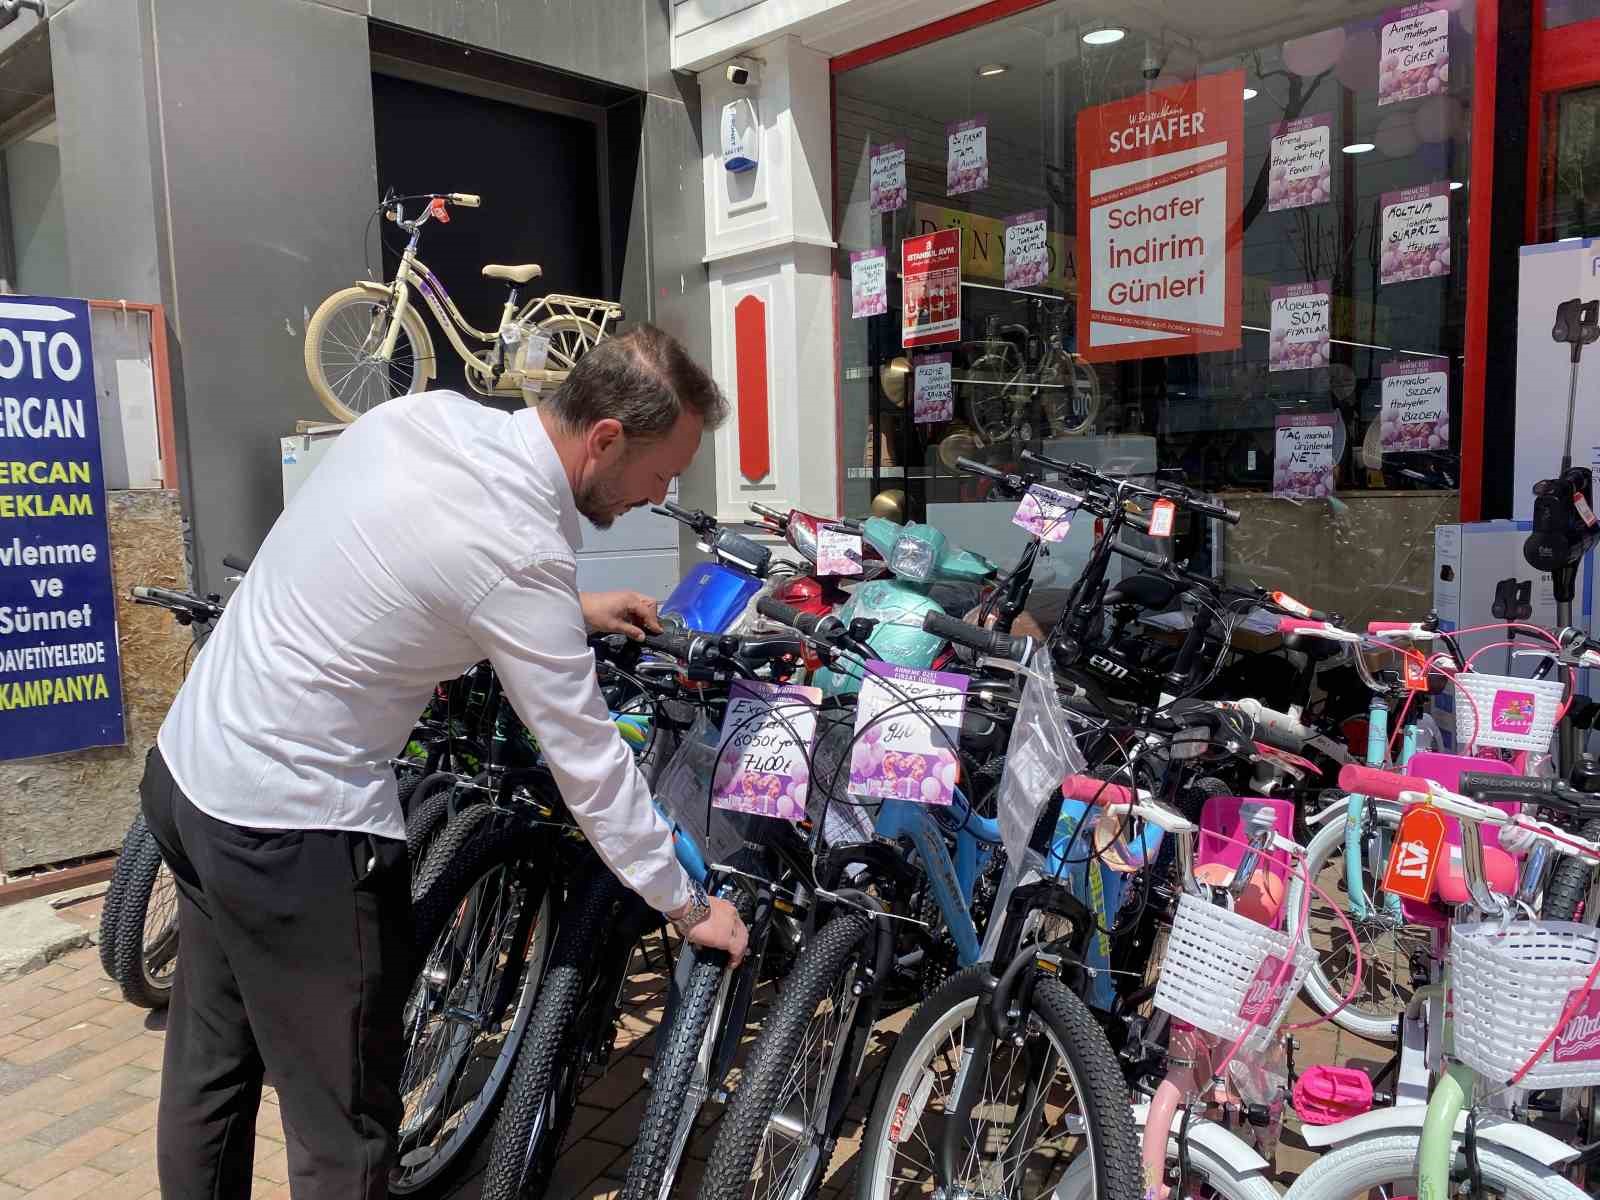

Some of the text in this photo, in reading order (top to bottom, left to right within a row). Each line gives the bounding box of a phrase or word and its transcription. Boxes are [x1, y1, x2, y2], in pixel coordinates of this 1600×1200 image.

[1108, 197, 1205, 229] Schafer
[1108, 269, 1205, 305] Günleri
[0, 494, 94, 518] EKLAM
[30, 577, 63, 597] ve
[0, 603, 93, 634] Sünnet
[0, 673, 109, 710] KAMPANYA
